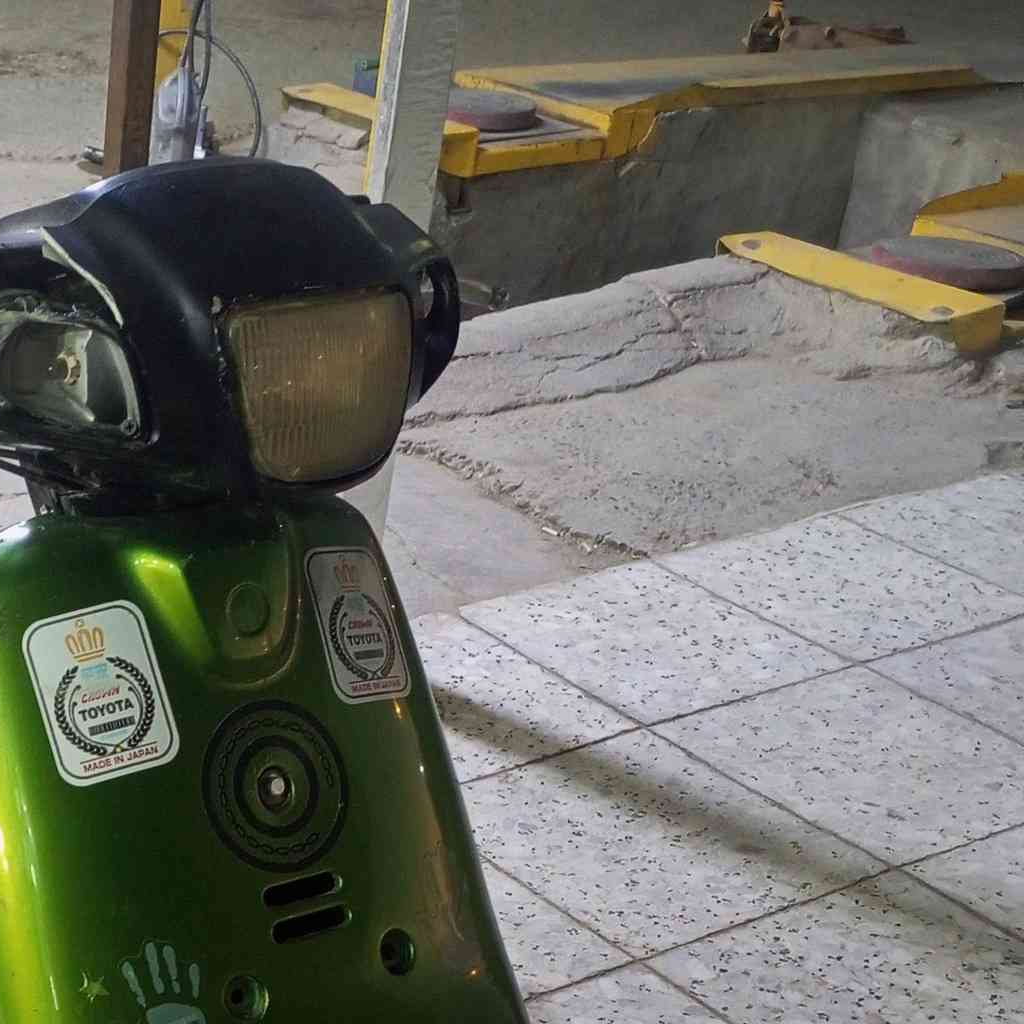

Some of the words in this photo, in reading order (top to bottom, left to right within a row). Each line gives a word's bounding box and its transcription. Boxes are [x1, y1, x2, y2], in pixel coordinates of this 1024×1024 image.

[78, 698, 134, 722] TOYOTA
[83, 758, 112, 772] MADE
[114, 755, 124, 764] IN
[127, 746, 159, 760] JAPAN
